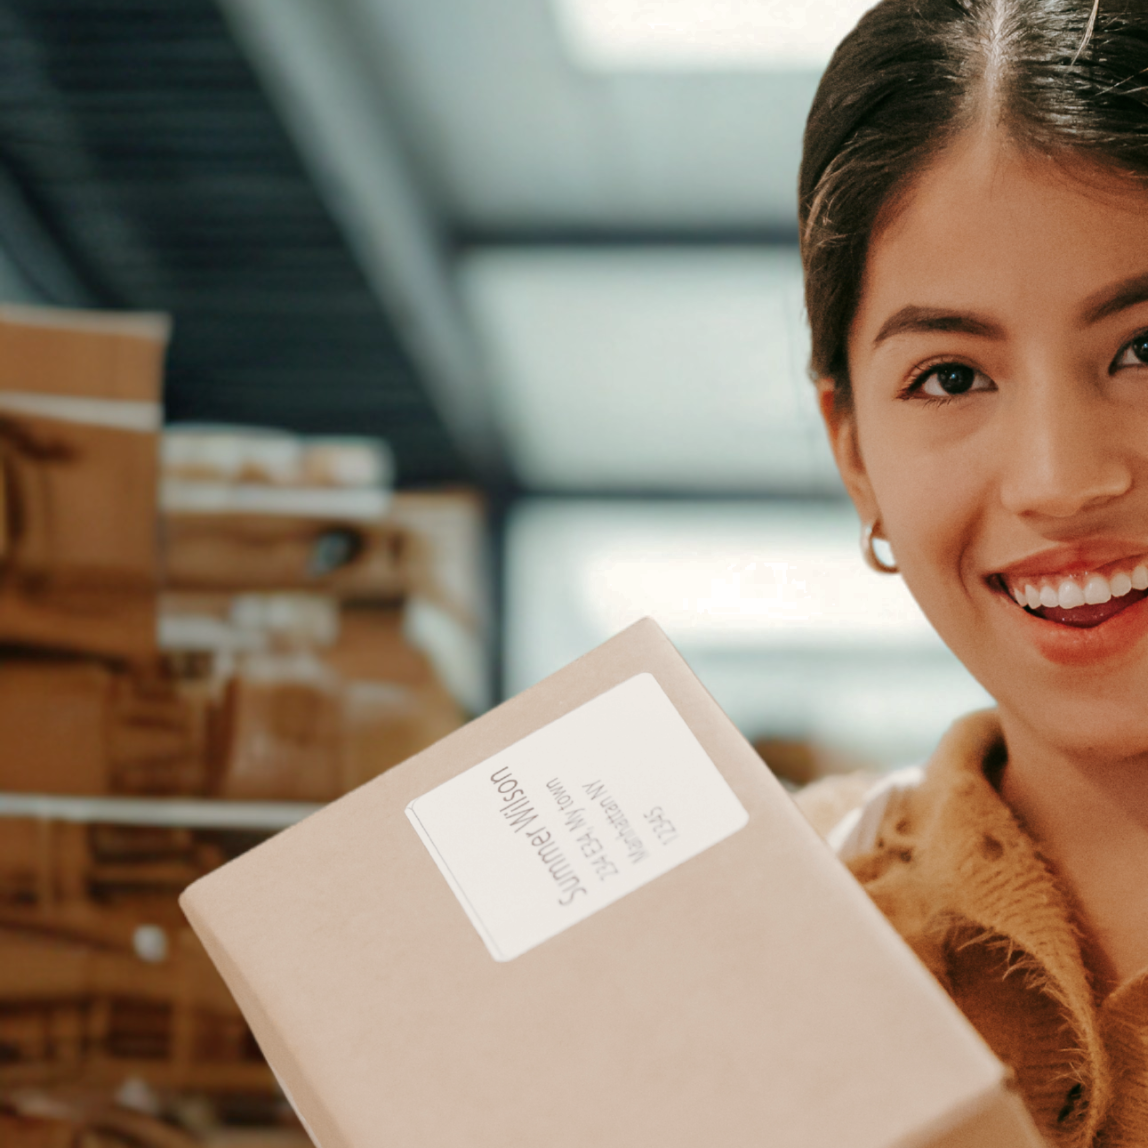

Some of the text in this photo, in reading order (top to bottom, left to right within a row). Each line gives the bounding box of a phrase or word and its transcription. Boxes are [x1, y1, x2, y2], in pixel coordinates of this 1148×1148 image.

[546, 777, 574, 811] town
[490, 766, 587, 906] Summer Wilson
[564, 808, 586, 832] My
[582, 780, 648, 864] Manhattan NY
[643, 806, 677, 845] 12345
[591, 855, 619, 881] 234
